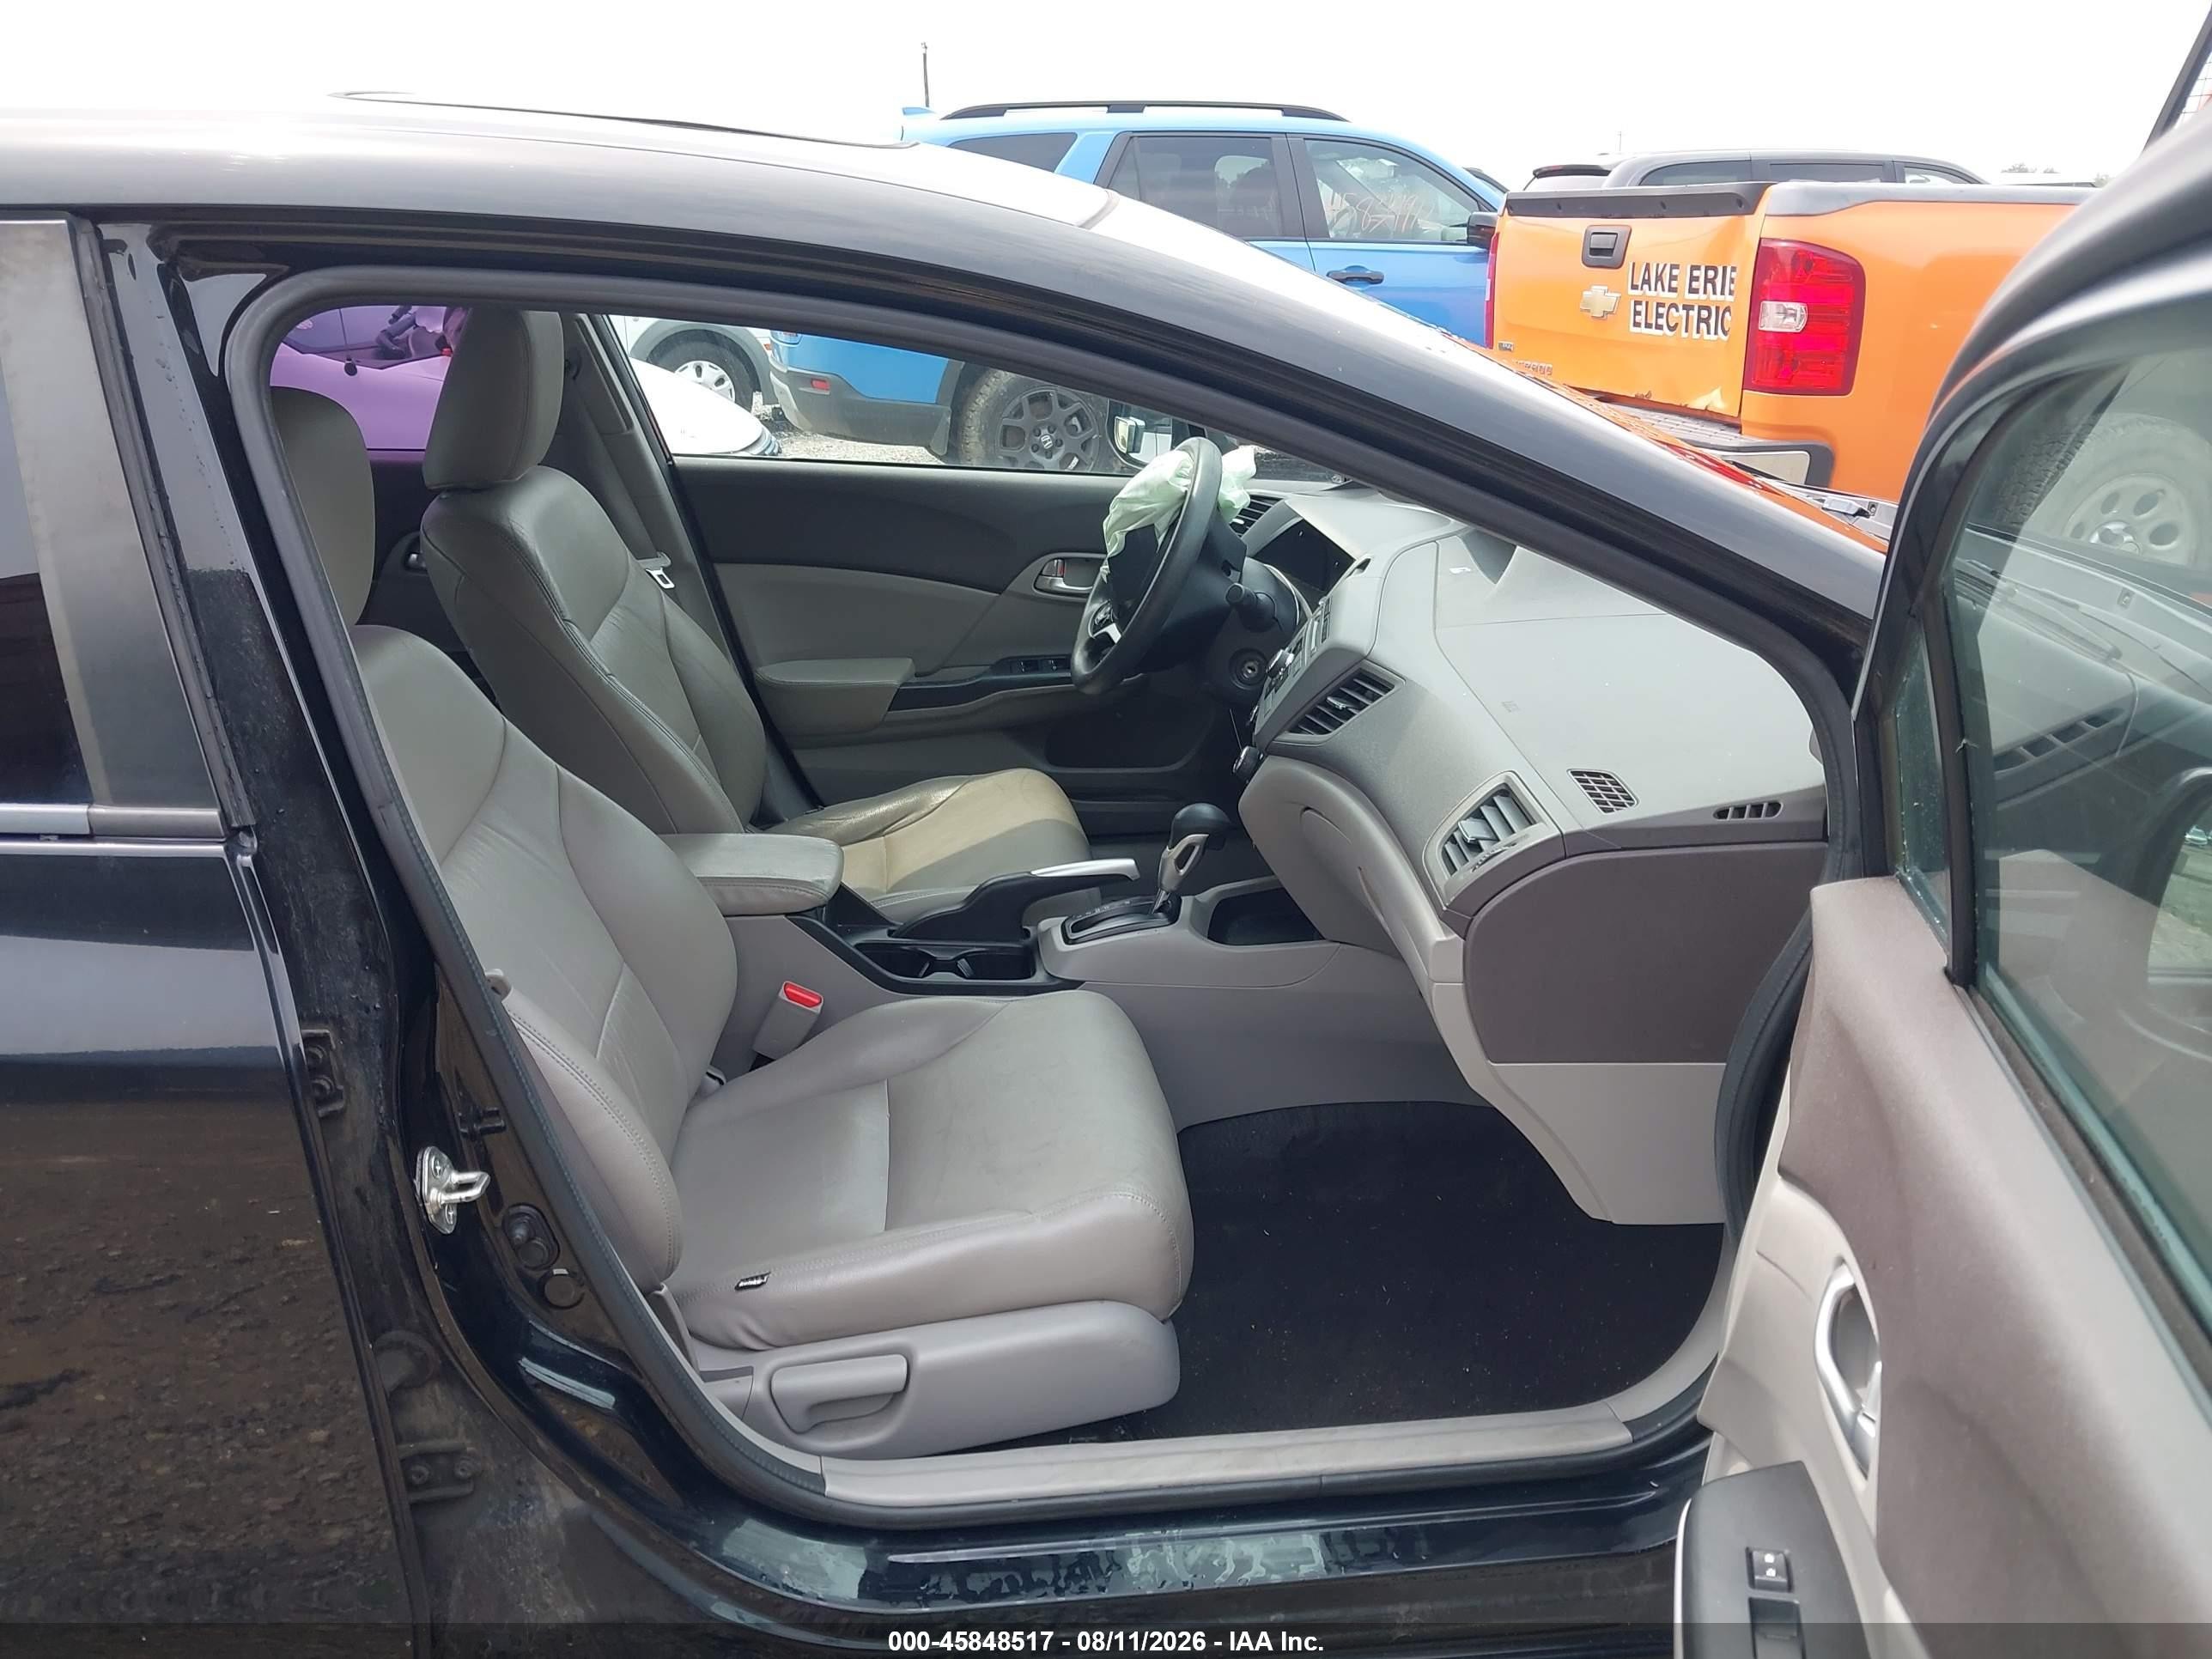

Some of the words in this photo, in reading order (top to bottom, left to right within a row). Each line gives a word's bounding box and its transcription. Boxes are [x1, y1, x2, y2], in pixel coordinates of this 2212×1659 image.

[1629, 261, 1680, 297] LAKE
[1686, 264, 1736, 301] ERIE
[1631, 299, 1732, 340] ELECTRIC
